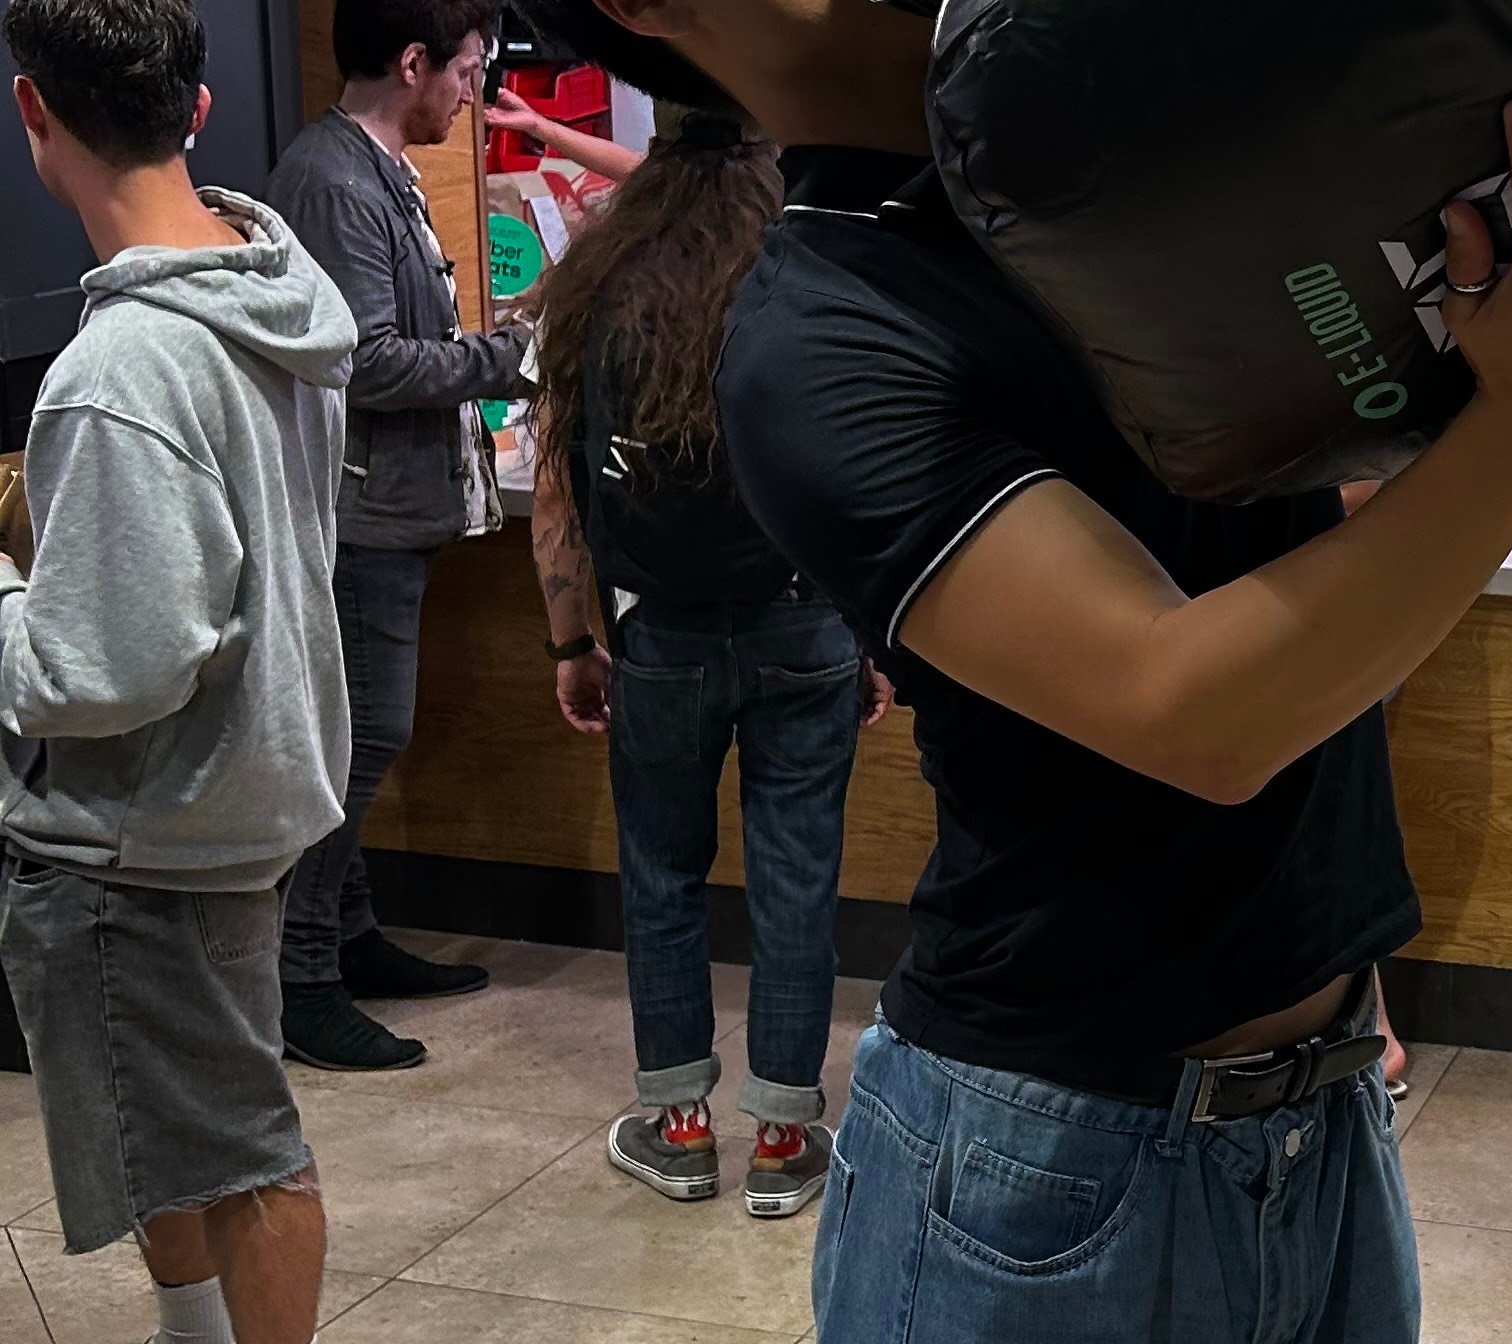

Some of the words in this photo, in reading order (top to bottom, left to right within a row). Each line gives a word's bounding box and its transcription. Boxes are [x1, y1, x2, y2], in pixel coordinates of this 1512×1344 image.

[491, 240, 524, 261] ber
[491, 261, 521, 278] ats
[1285, 262, 1387, 387] E-LIQUID
